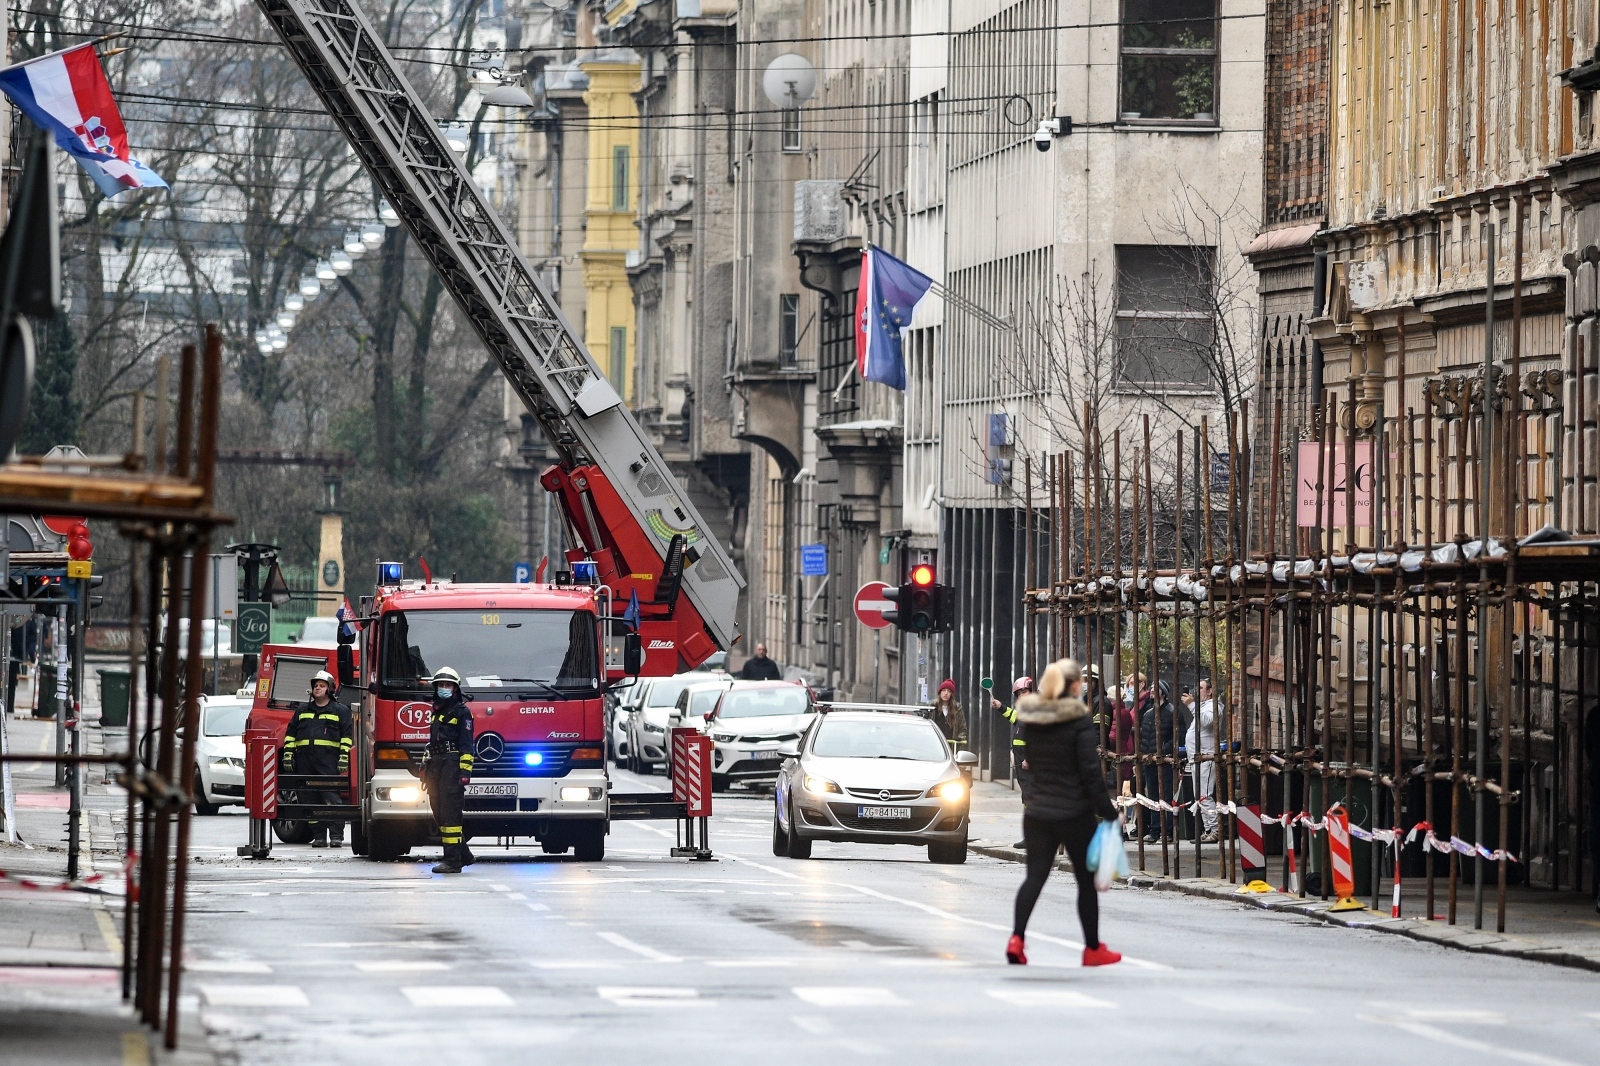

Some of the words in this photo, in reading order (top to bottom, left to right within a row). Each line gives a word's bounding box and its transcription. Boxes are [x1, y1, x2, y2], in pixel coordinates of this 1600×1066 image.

[240, 615, 268, 632] Teo
[481, 614, 500, 625] 130
[648, 640, 674, 649] Metz
[520, 706, 555, 714] CENTAR
[408, 710, 432, 723] 193
[469, 786, 479, 795] ZG
[864, 808, 874, 816] ZG
